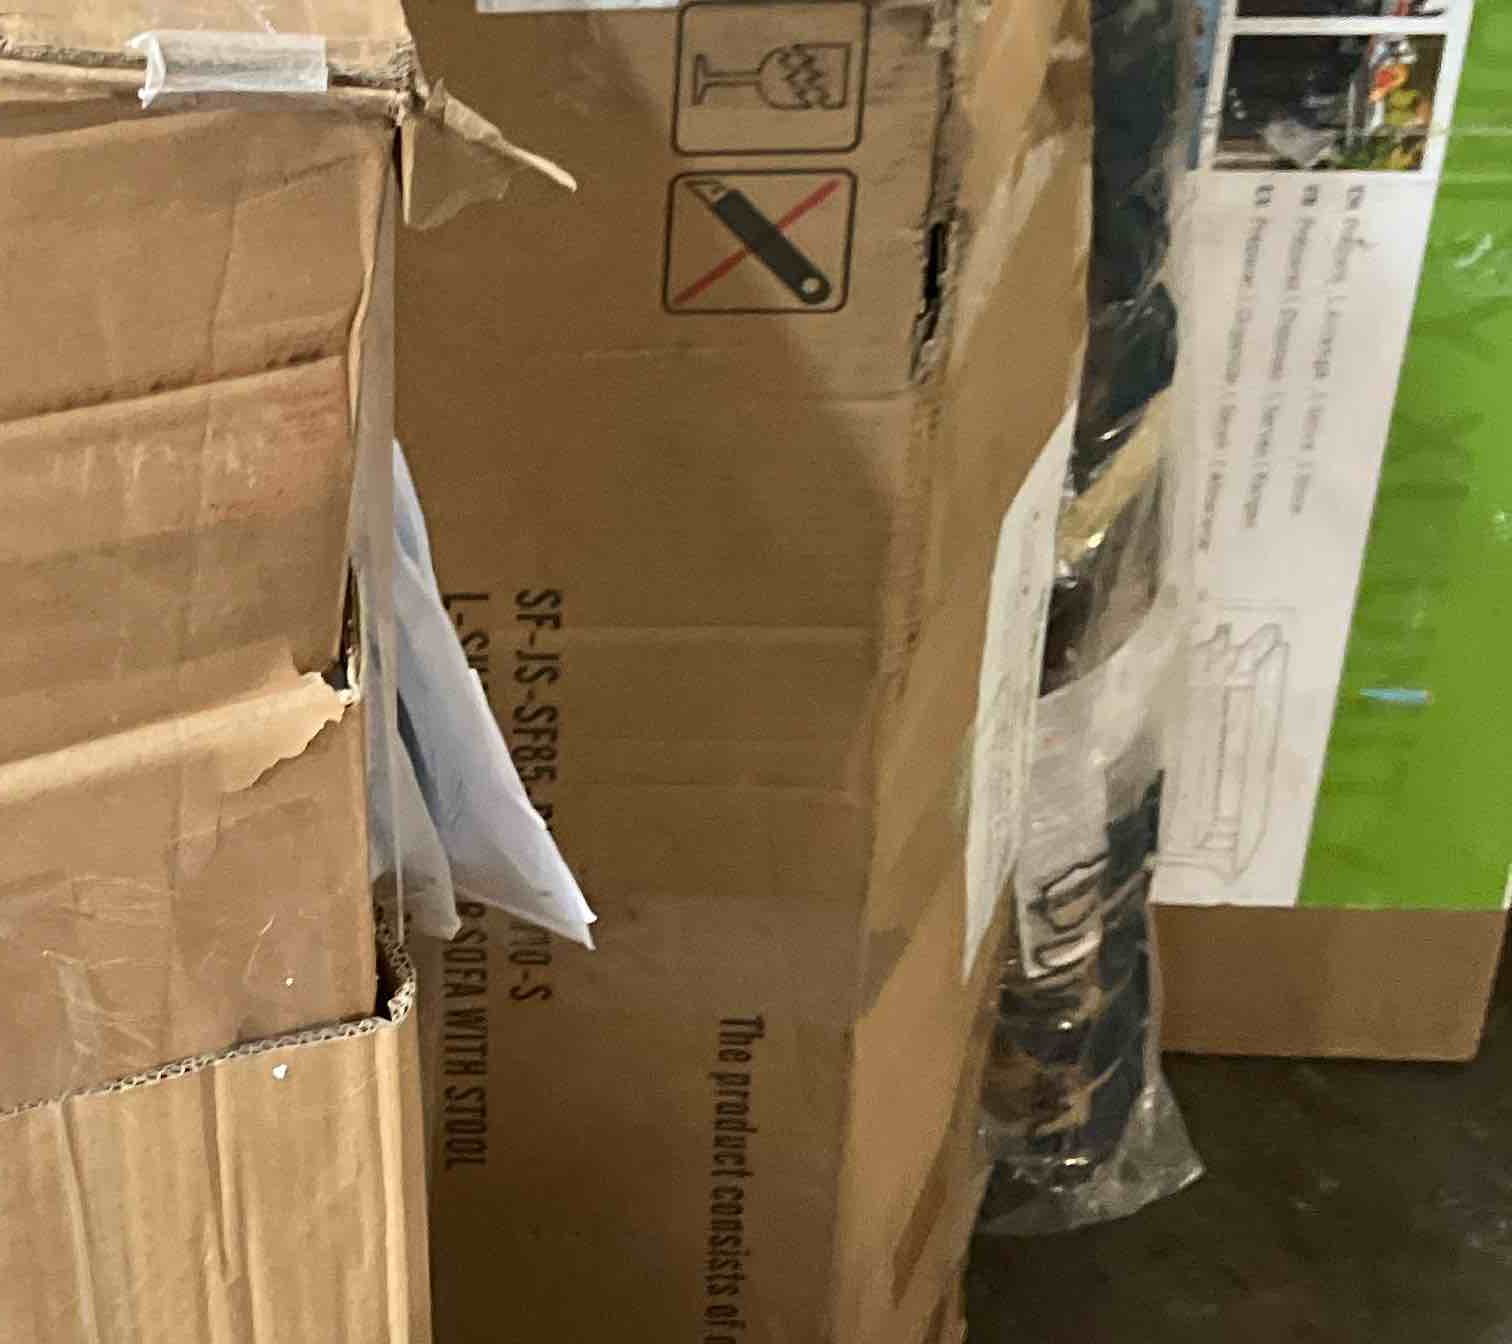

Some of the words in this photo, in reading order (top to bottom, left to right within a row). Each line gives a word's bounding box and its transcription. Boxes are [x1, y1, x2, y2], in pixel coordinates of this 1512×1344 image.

[443, 1006, 489, 1074] WITH
[719, 1015, 766, 1063] The
[443, 1086, 489, 1172] STOOL
[710, 1072, 759, 1178] product
[704, 1184, 751, 1298] consists
[703, 1304, 747, 1328] of
